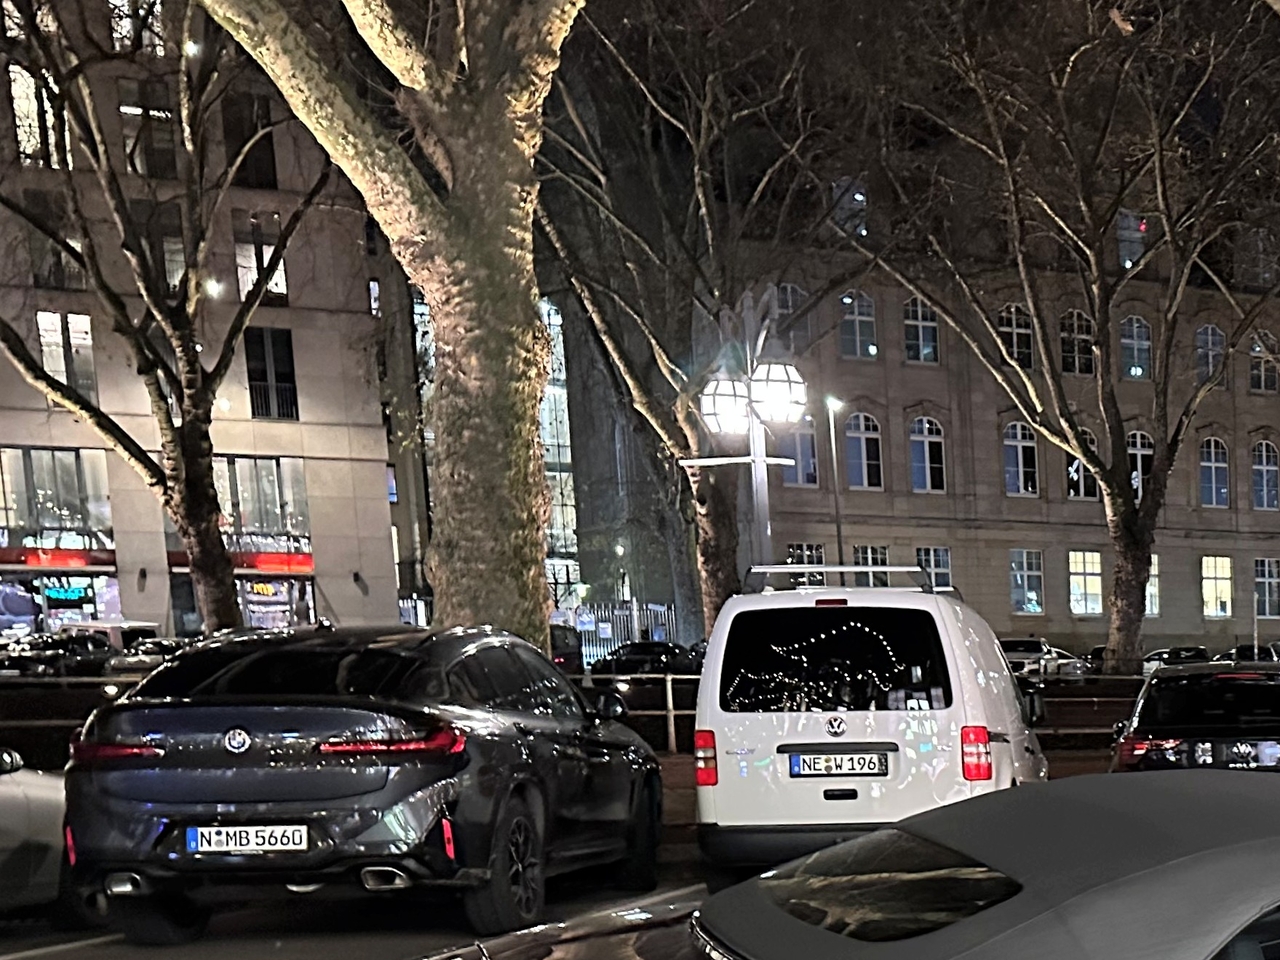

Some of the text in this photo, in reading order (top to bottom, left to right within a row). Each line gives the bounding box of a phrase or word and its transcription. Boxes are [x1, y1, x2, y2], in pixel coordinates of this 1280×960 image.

[802, 759, 822, 772] NE
[834, 759, 843, 771] W
[848, 757, 876, 770] 196
[200, 830, 212, 848] N
[225, 830, 250, 846] MB
[255, 829, 303, 846] 5660
